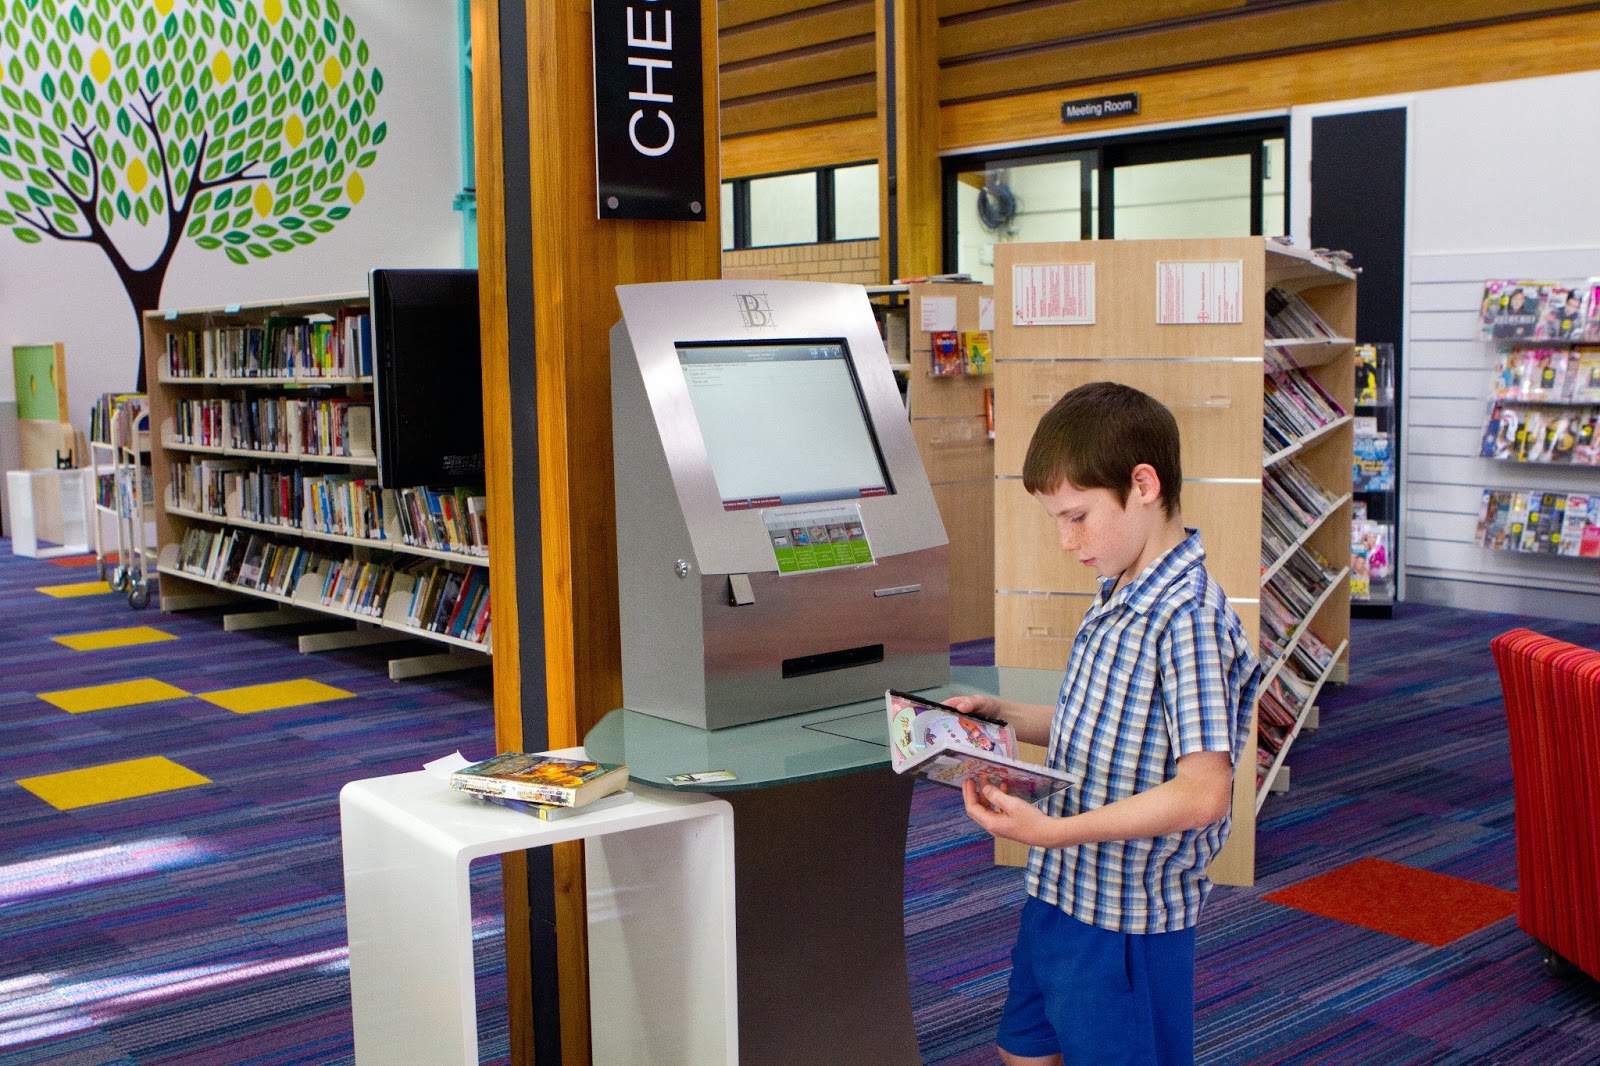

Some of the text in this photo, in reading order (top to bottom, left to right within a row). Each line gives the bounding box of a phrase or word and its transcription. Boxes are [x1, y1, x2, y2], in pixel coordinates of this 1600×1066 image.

[627, 0, 675, 157] CHE
[1067, 100, 1132, 117] Meeting Room
